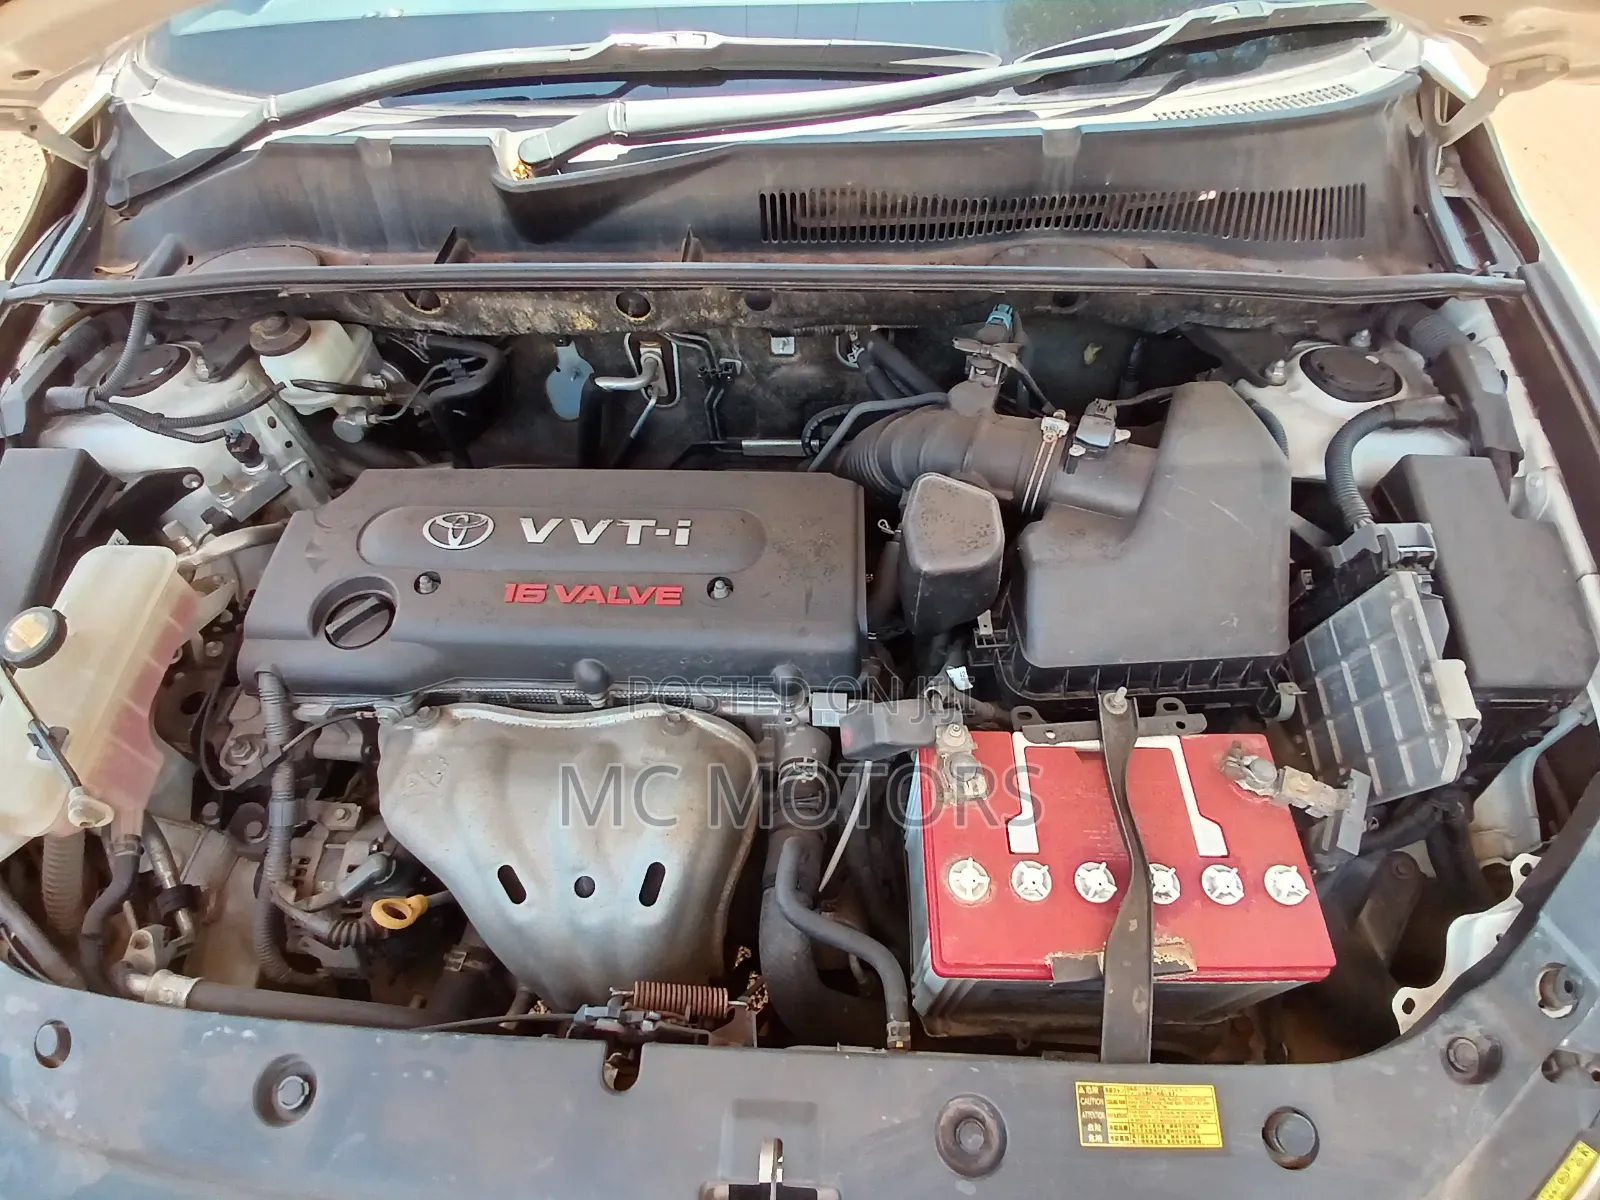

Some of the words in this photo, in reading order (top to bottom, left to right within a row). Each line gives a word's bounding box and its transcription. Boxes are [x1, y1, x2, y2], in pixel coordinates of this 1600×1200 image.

[519, 517, 692, 547] VVT-i
[504, 583, 548, 604] 16
[553, 584, 684, 606] VALVE
[1080, 1097, 1104, 1106] CAUTION
